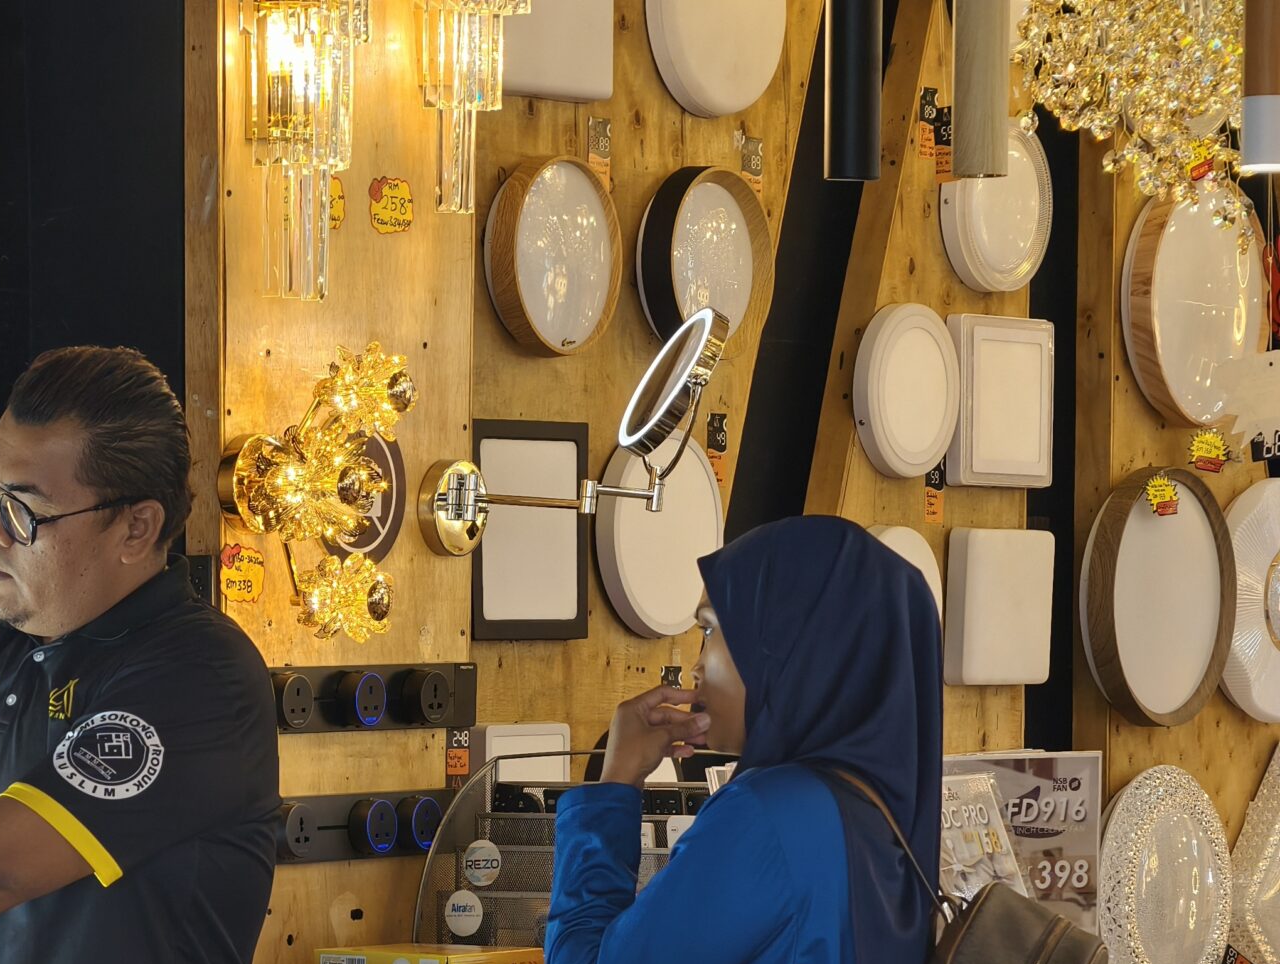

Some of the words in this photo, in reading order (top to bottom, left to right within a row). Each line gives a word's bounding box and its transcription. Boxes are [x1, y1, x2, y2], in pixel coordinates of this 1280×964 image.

[716, 431, 726, 446] 49
[99, 713, 155, 741] SOKONG
[452, 730, 469, 747] 248
[55, 752, 117, 798] MUSLIM
[1053, 777, 1068, 785] NSB
[962, 803, 990, 826] PRO
[1006, 798, 1087, 823] FD916
[465, 859, 500, 870] REZO
[1034, 859, 1089, 890] 398
